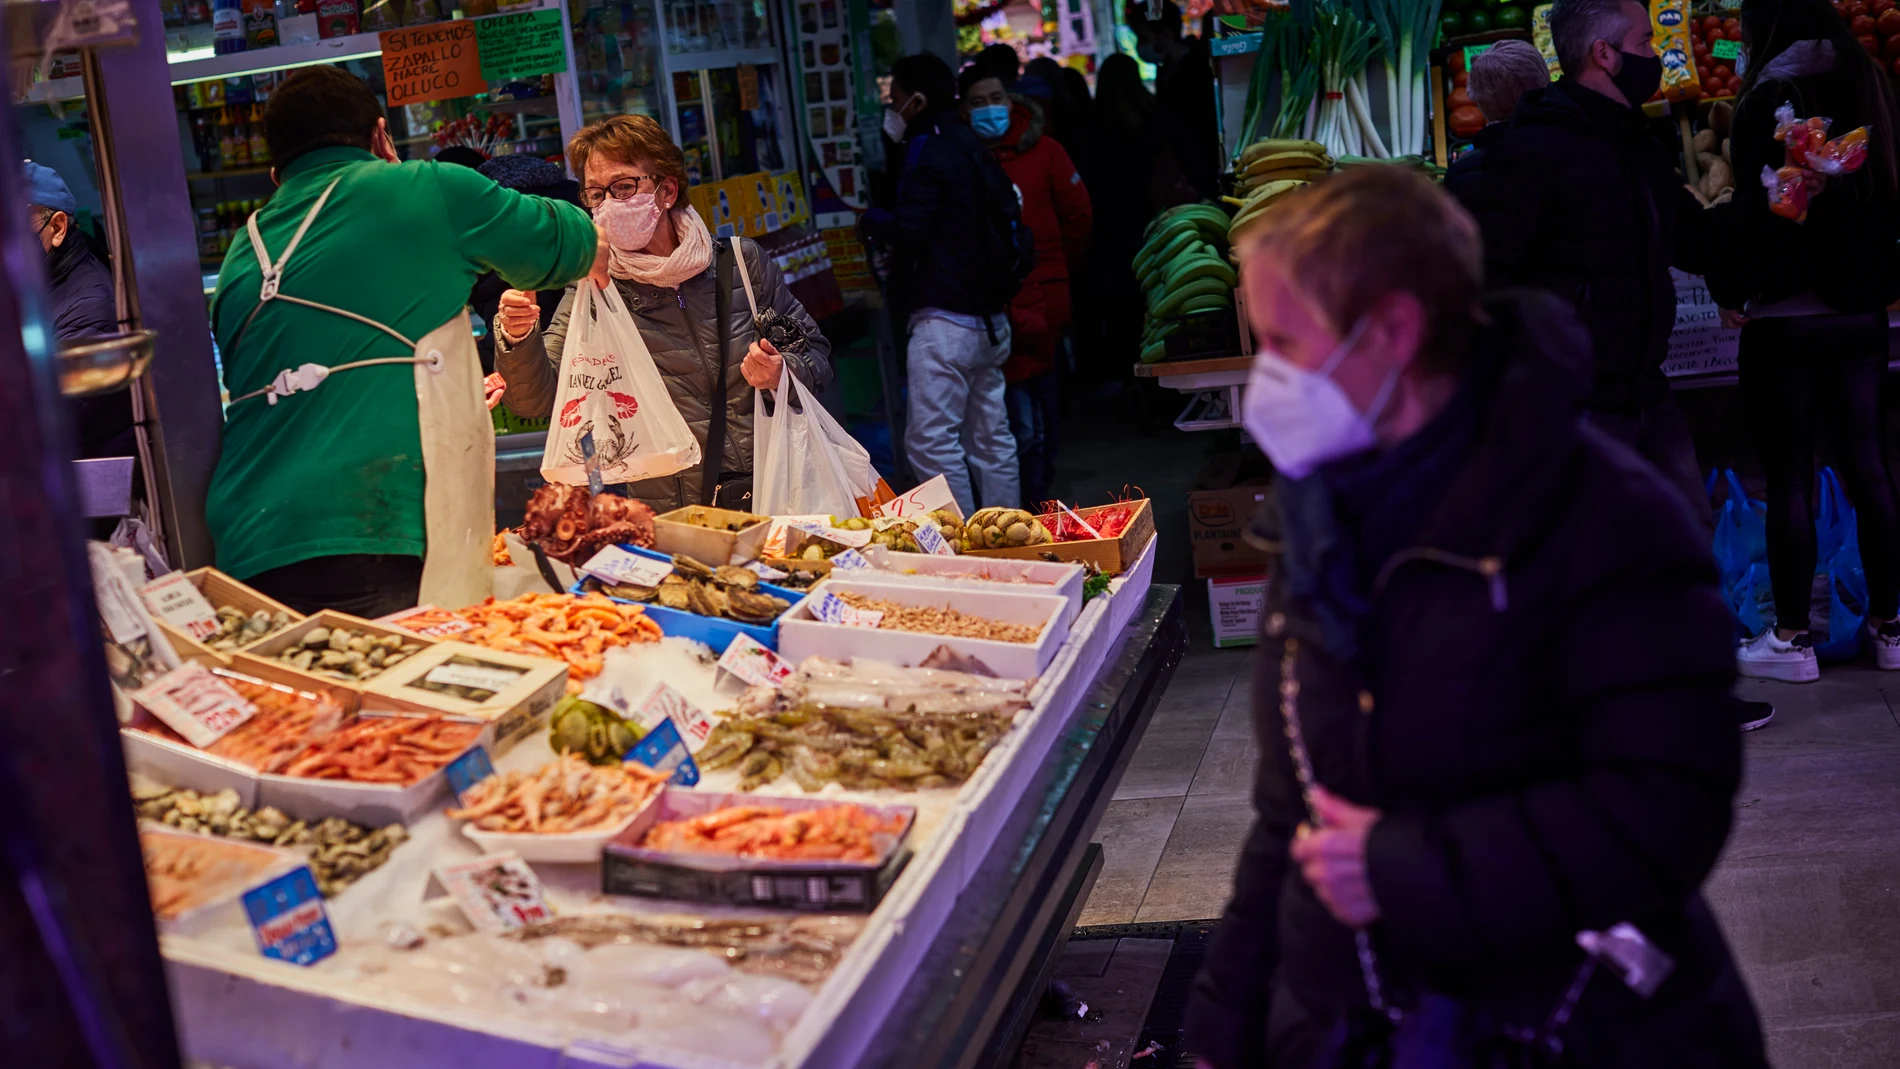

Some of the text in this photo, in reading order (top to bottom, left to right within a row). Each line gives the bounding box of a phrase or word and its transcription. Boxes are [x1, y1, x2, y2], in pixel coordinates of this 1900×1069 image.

[481, 12, 536, 30] OFERTA
[388, 32, 407, 52] SI
[411, 24, 475, 47] TENEMOS
[393, 62, 440, 82] MACRE
